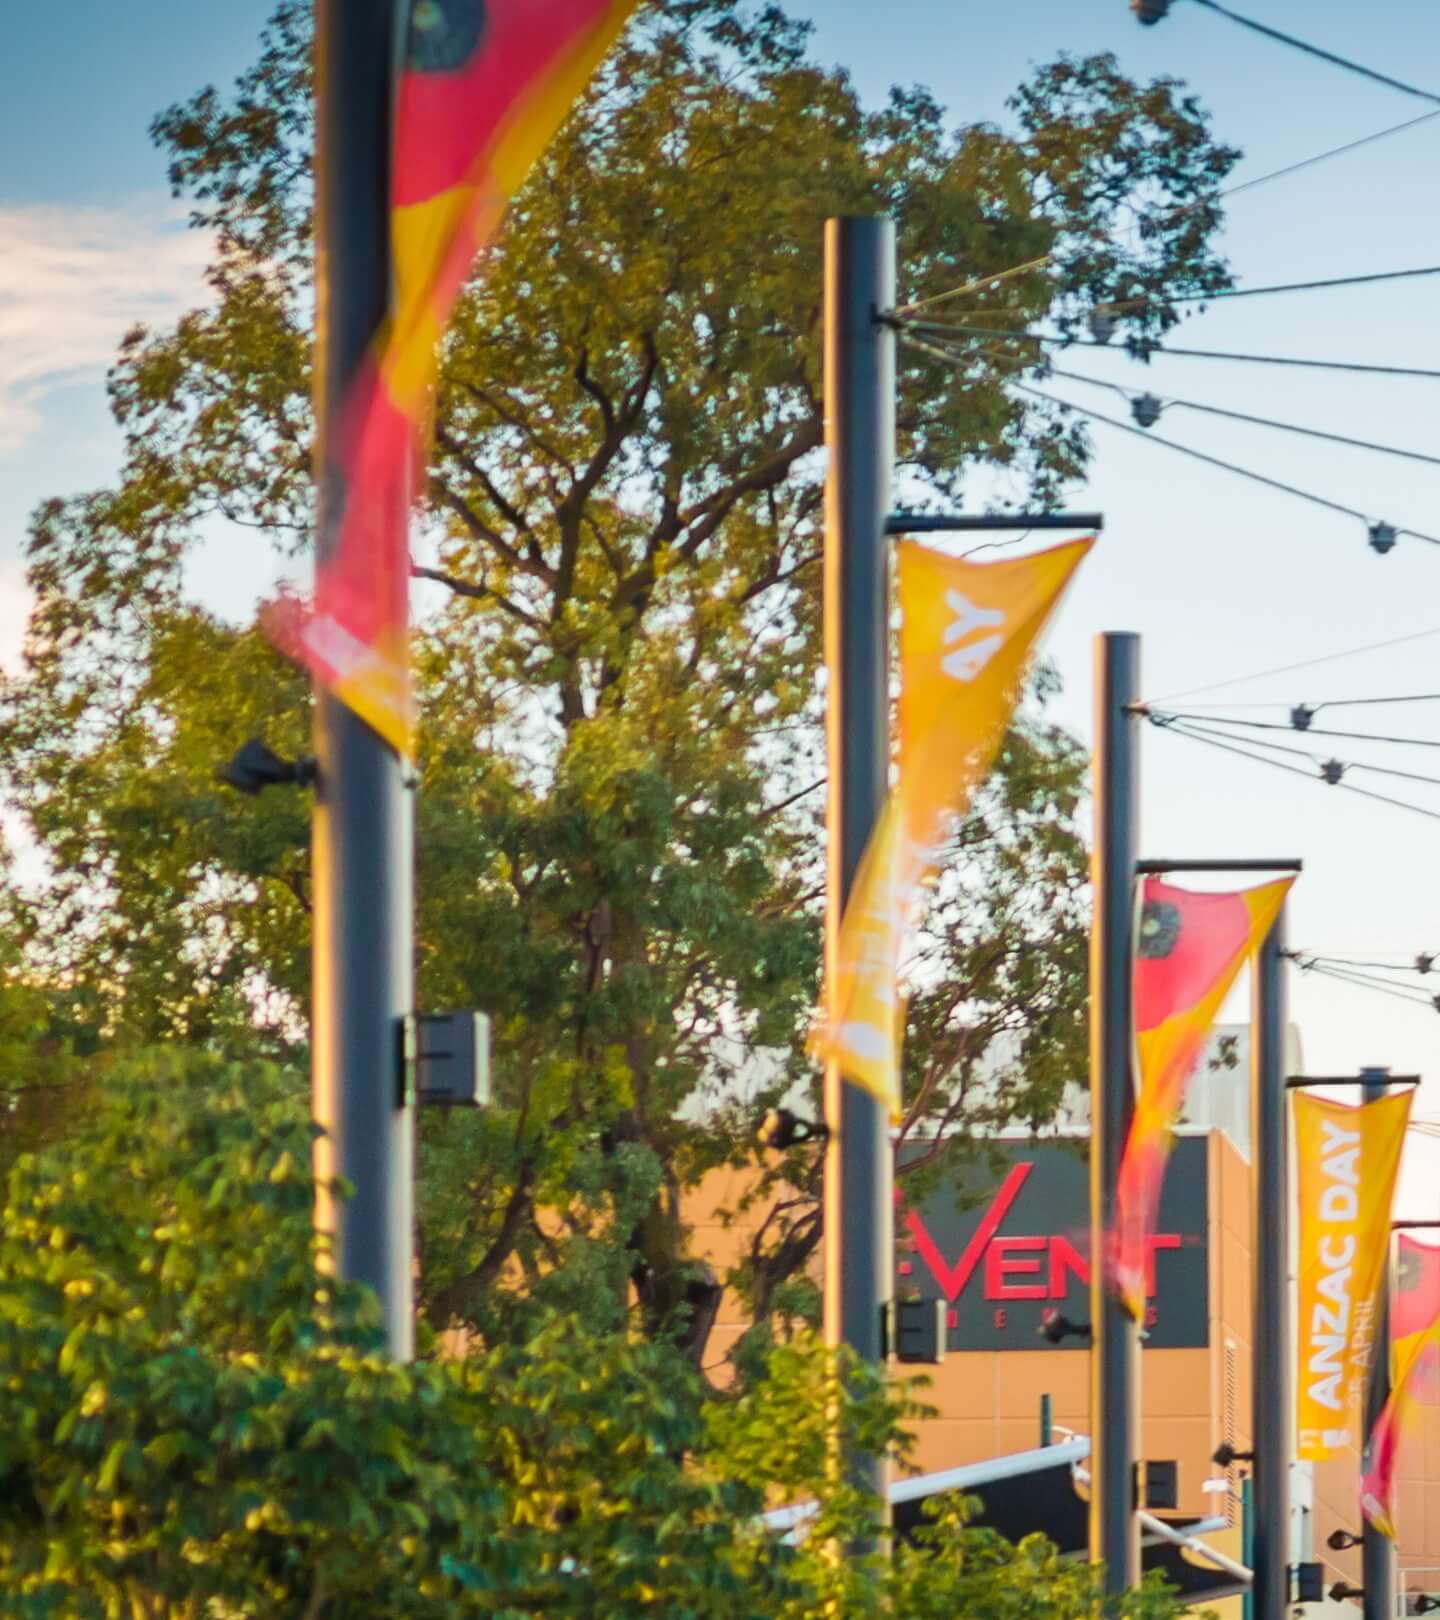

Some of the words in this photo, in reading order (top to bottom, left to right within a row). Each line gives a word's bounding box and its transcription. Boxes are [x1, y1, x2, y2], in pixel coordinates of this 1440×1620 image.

[893, 1161, 1185, 1301] VENT
[1319, 1119, 1363, 1223] DAY
[1308, 1233, 1357, 1411] ANZAC
